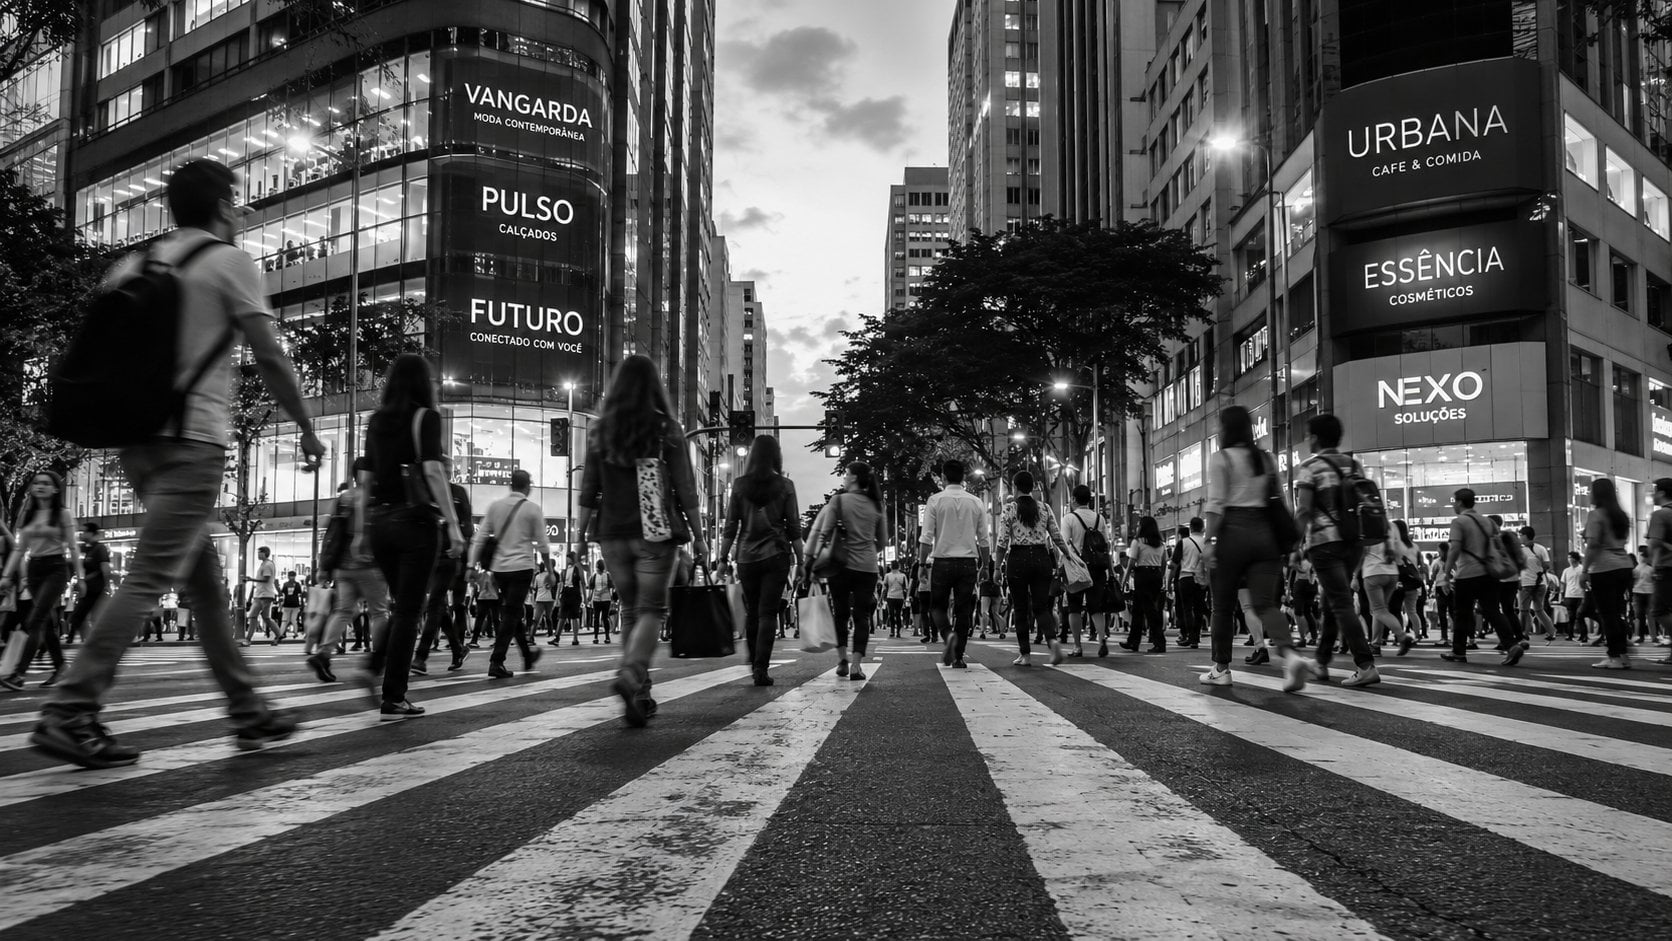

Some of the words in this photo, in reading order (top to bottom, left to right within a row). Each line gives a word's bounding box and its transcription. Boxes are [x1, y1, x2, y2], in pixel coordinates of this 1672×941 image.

[464, 82, 593, 128] VANGARDA
[473, 112, 502, 125] MODA
[504, 118, 585, 142] CONTEMPORÂNEA
[1348, 105, 1508, 158] URBANA
[1372, 161, 1406, 177] CAFE
[1411, 159, 1421, 170] &
[1426, 150, 1482, 167] COMIDA
[482, 185, 574, 225] PULSO
[499, 223, 558, 242] CALÇADOS
[1364, 246, 1505, 289] ESSÊNCIA
[1389, 285, 1474, 306] COSMÉTICOS
[471, 298, 584, 336] FUTURO
[469, 332, 531, 347] CONECTADO
[533, 339, 555, 350] COM
[1377, 371, 1483, 409] NEXO
[1394, 406, 1467, 425] SOLUÇÕES
